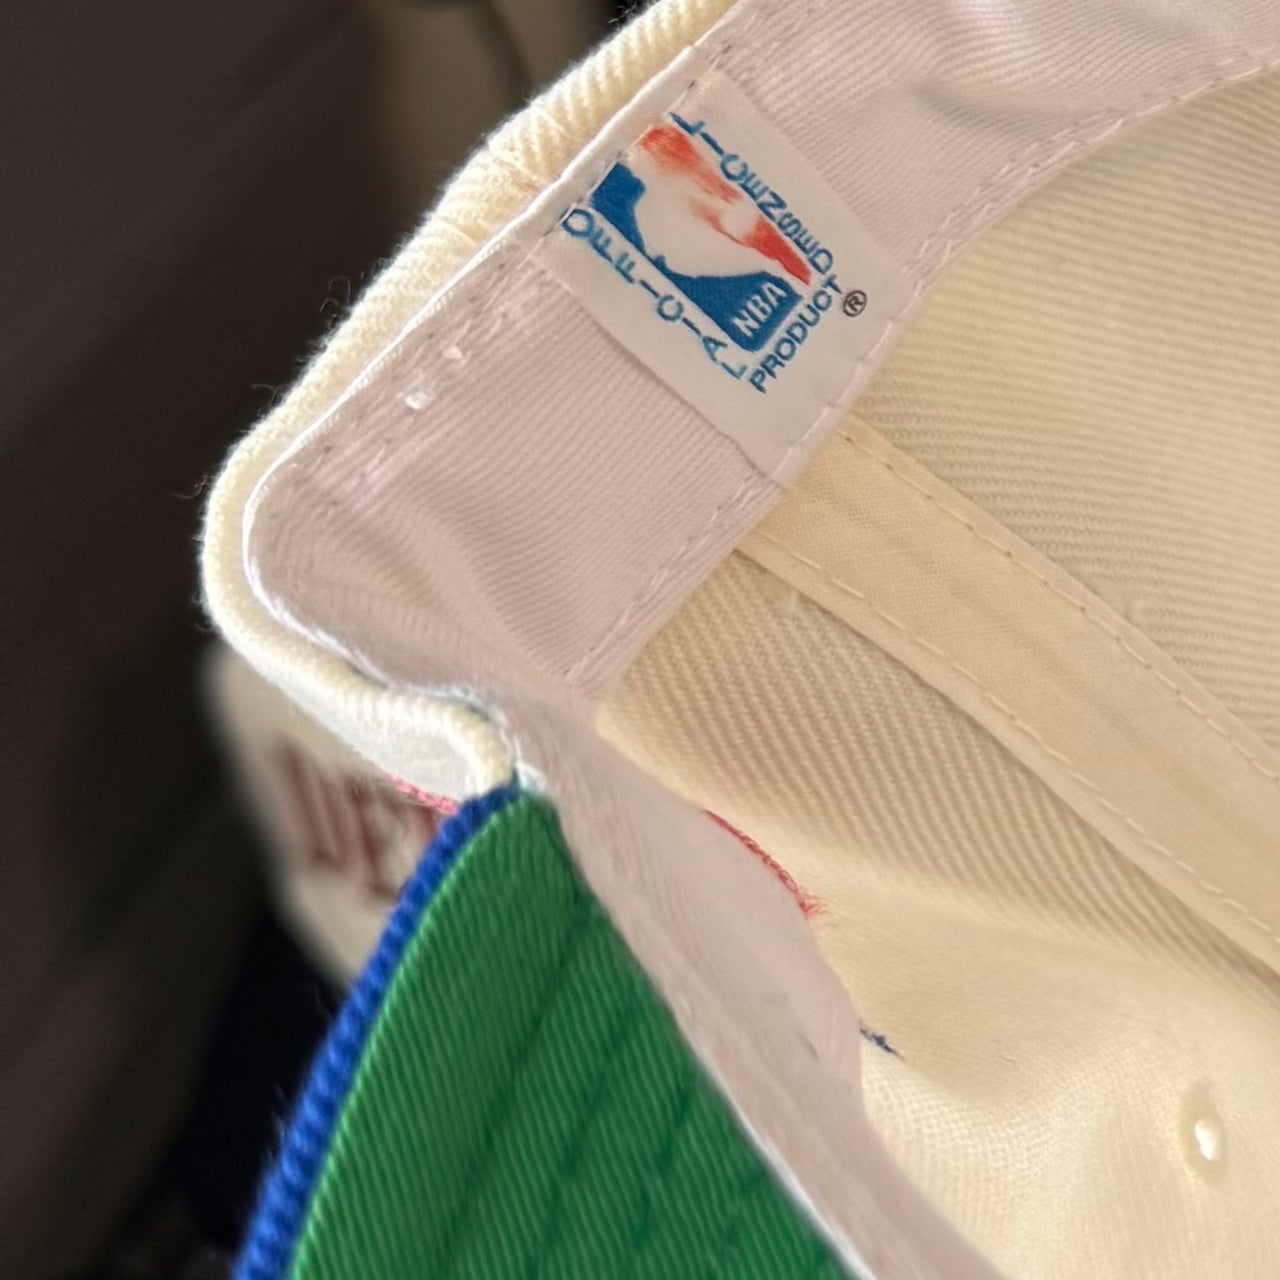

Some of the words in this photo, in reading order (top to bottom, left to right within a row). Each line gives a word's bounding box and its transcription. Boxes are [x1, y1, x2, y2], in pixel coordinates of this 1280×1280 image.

[668, 111, 834, 276] LICENSED
[560, 206, 746, 381] OFFICIAL
[731, 280, 790, 339] NBA
[748, 274, 843, 395] PRODUCT
